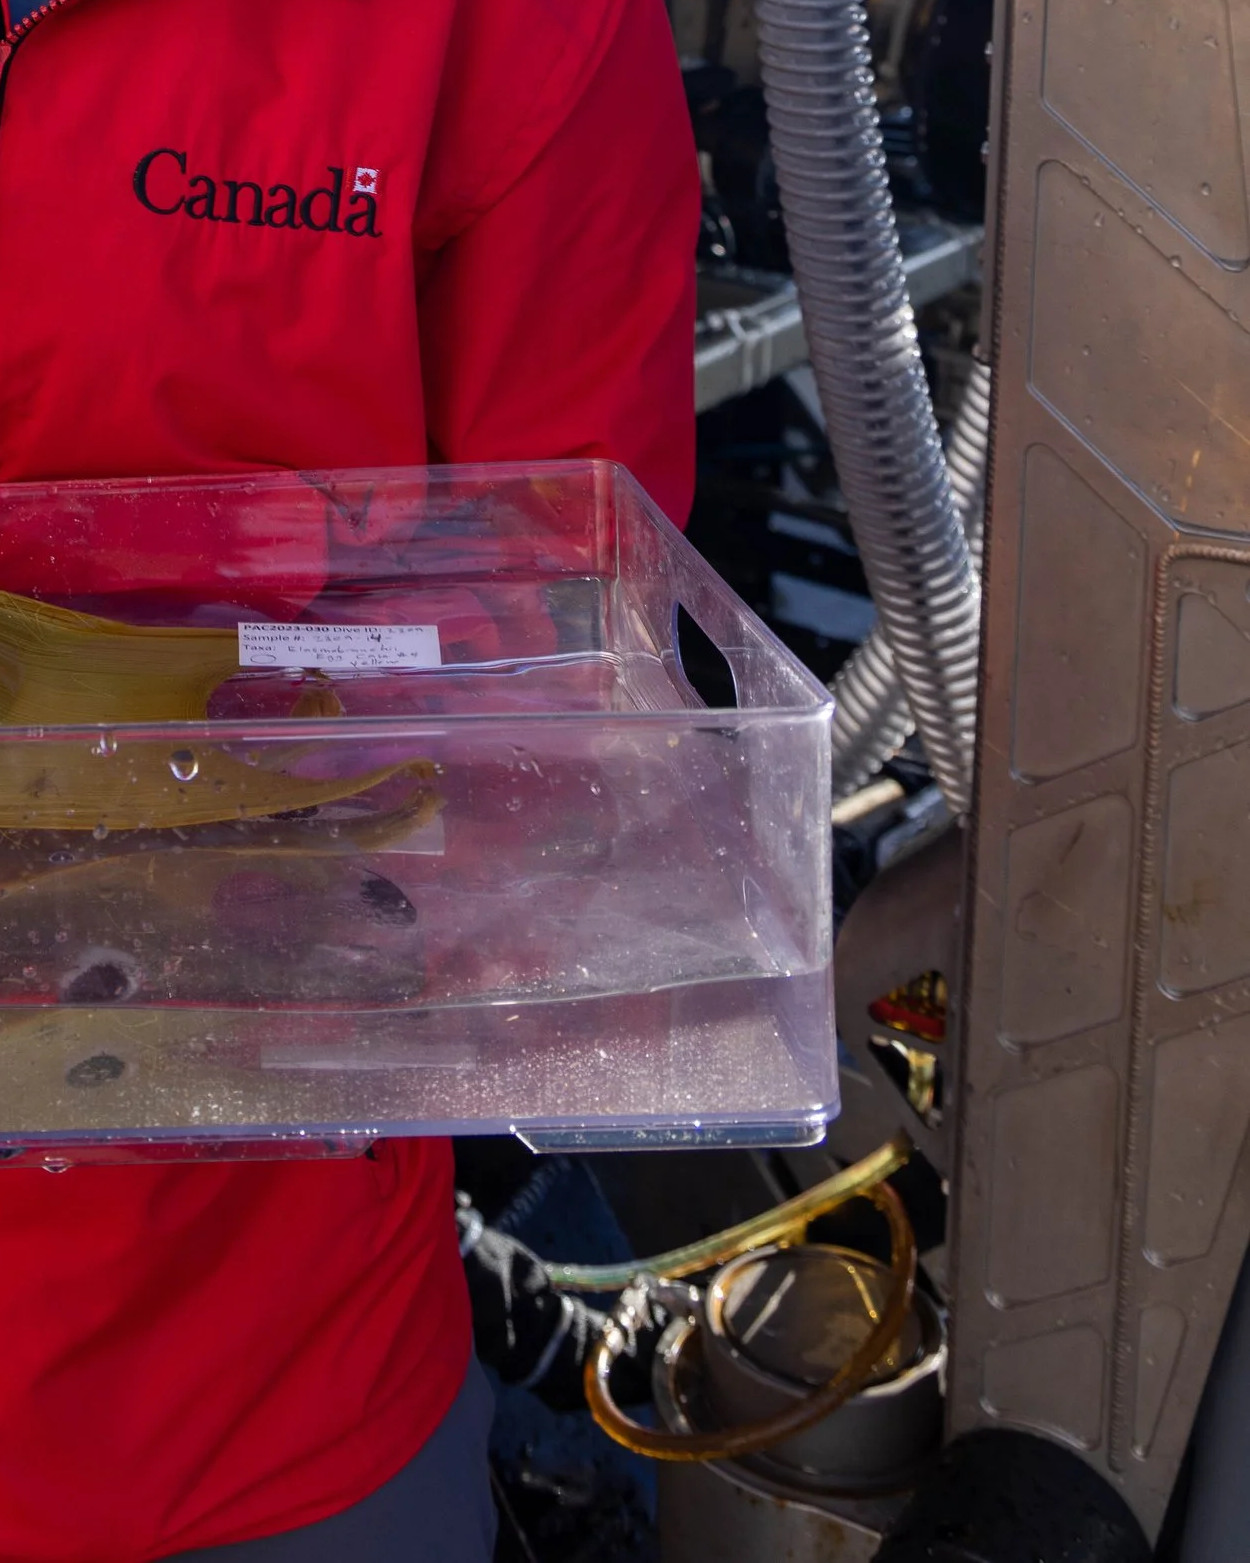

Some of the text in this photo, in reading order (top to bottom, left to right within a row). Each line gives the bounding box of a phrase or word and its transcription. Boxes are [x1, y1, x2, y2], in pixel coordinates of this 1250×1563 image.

[132, 147, 383, 239] Canada
[333, 625, 360, 634] Dive
[365, 626, 382, 634] ID:
[243, 633, 292, 643] Sample
[244, 644, 277, 652] Taxa:
